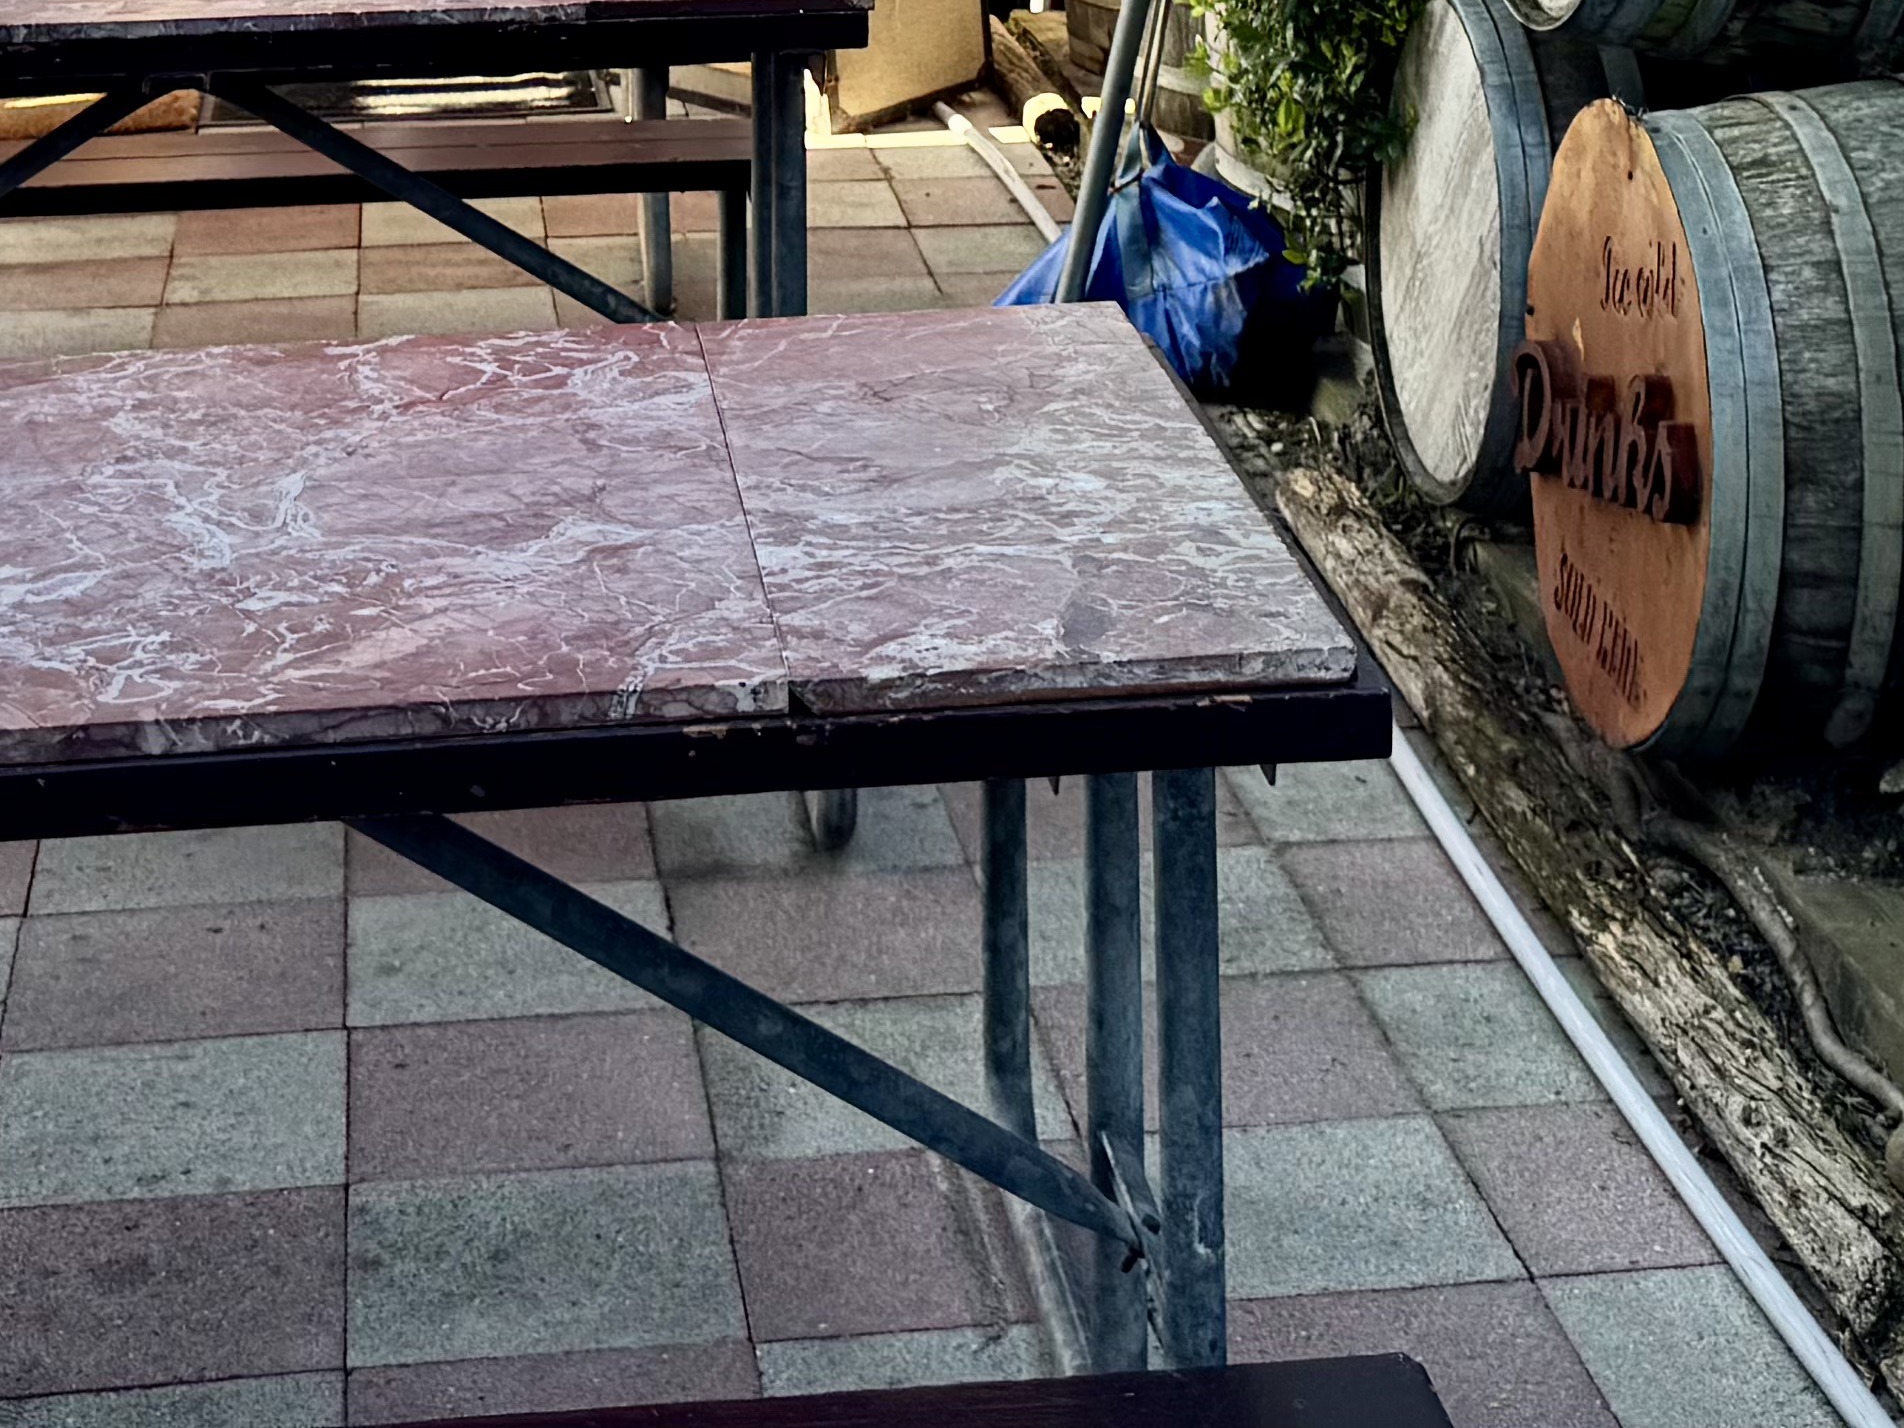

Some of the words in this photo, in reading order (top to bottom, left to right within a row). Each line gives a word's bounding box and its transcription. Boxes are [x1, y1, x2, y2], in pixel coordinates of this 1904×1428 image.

[1600, 236, 1632, 316] Ice
[1637, 239, 1681, 319] cold
[1514, 341, 1678, 522] Drinks
[1554, 552, 1596, 644] SOLD
